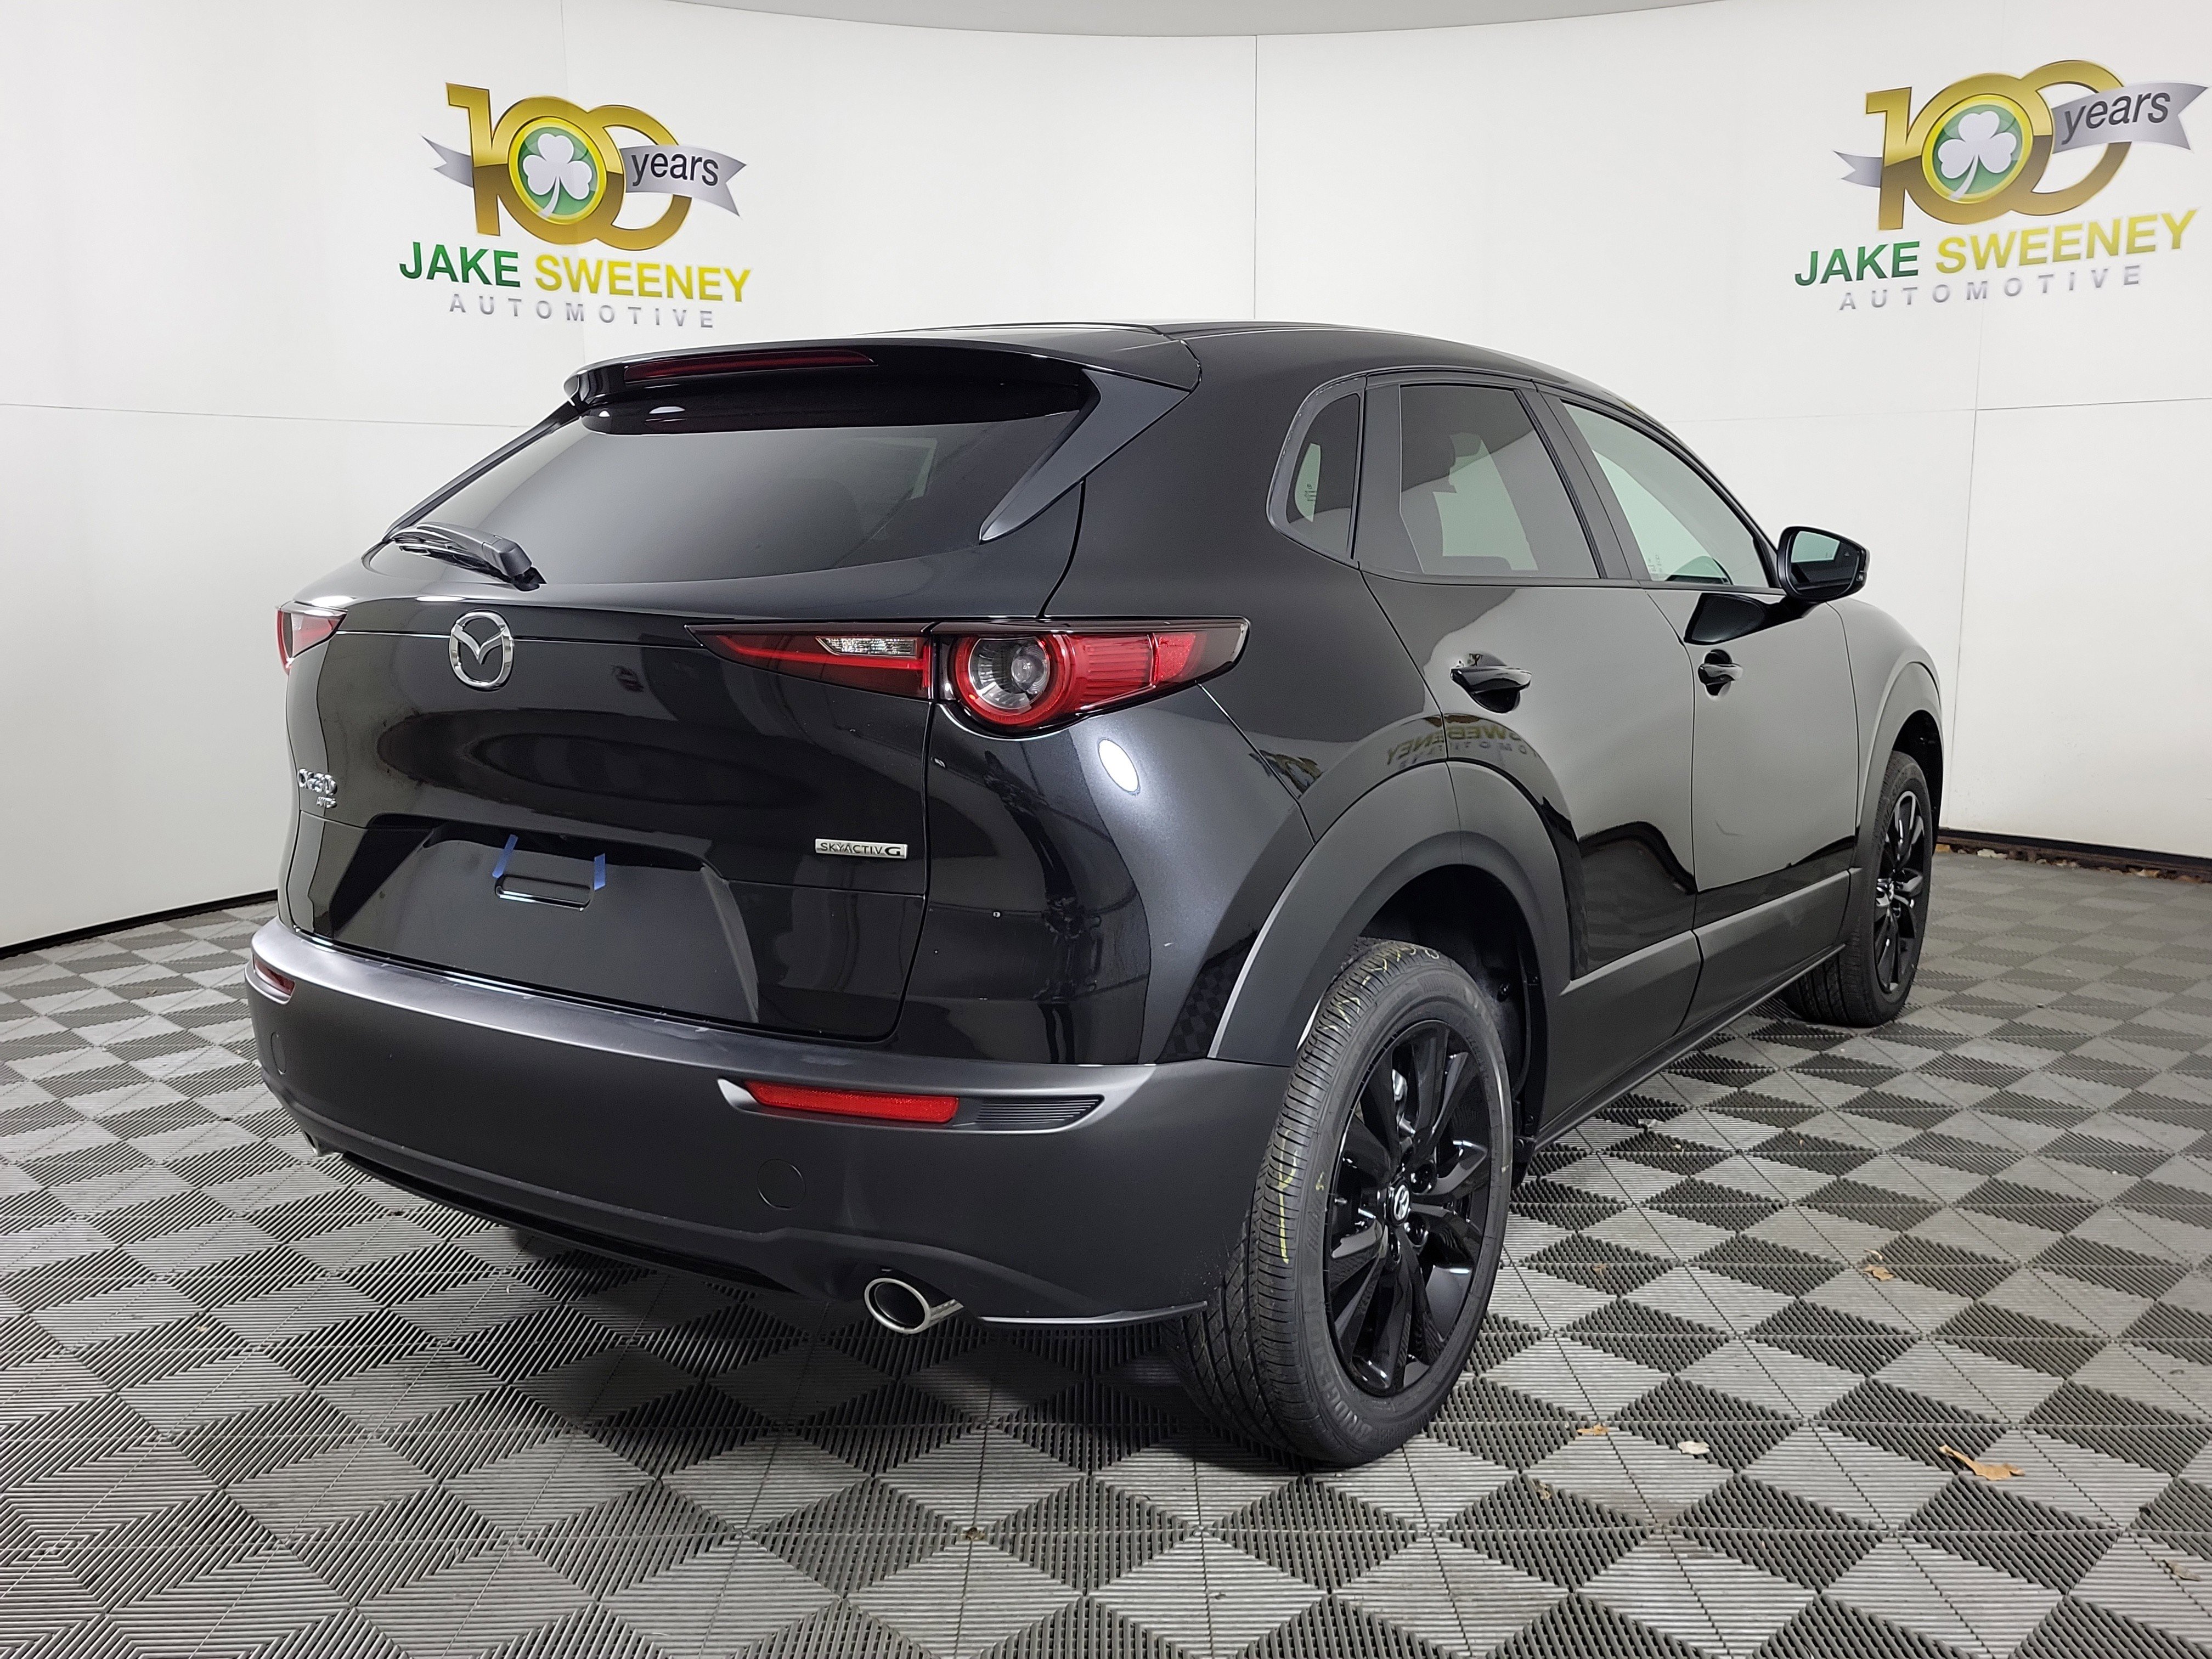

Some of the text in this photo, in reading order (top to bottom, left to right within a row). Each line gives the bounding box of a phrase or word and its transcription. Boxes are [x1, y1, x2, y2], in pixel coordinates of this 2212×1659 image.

[2062, 90, 2171, 145] years
[631, 152, 719, 187] years
[399, 241, 751, 302] JAKE SWEENEY
[1795, 208, 2197, 286] JAKE SWEENEY
[449, 294, 714, 328] AUTOMOTIVE
[1839, 265, 2141, 311] AUTOMOTIVE
